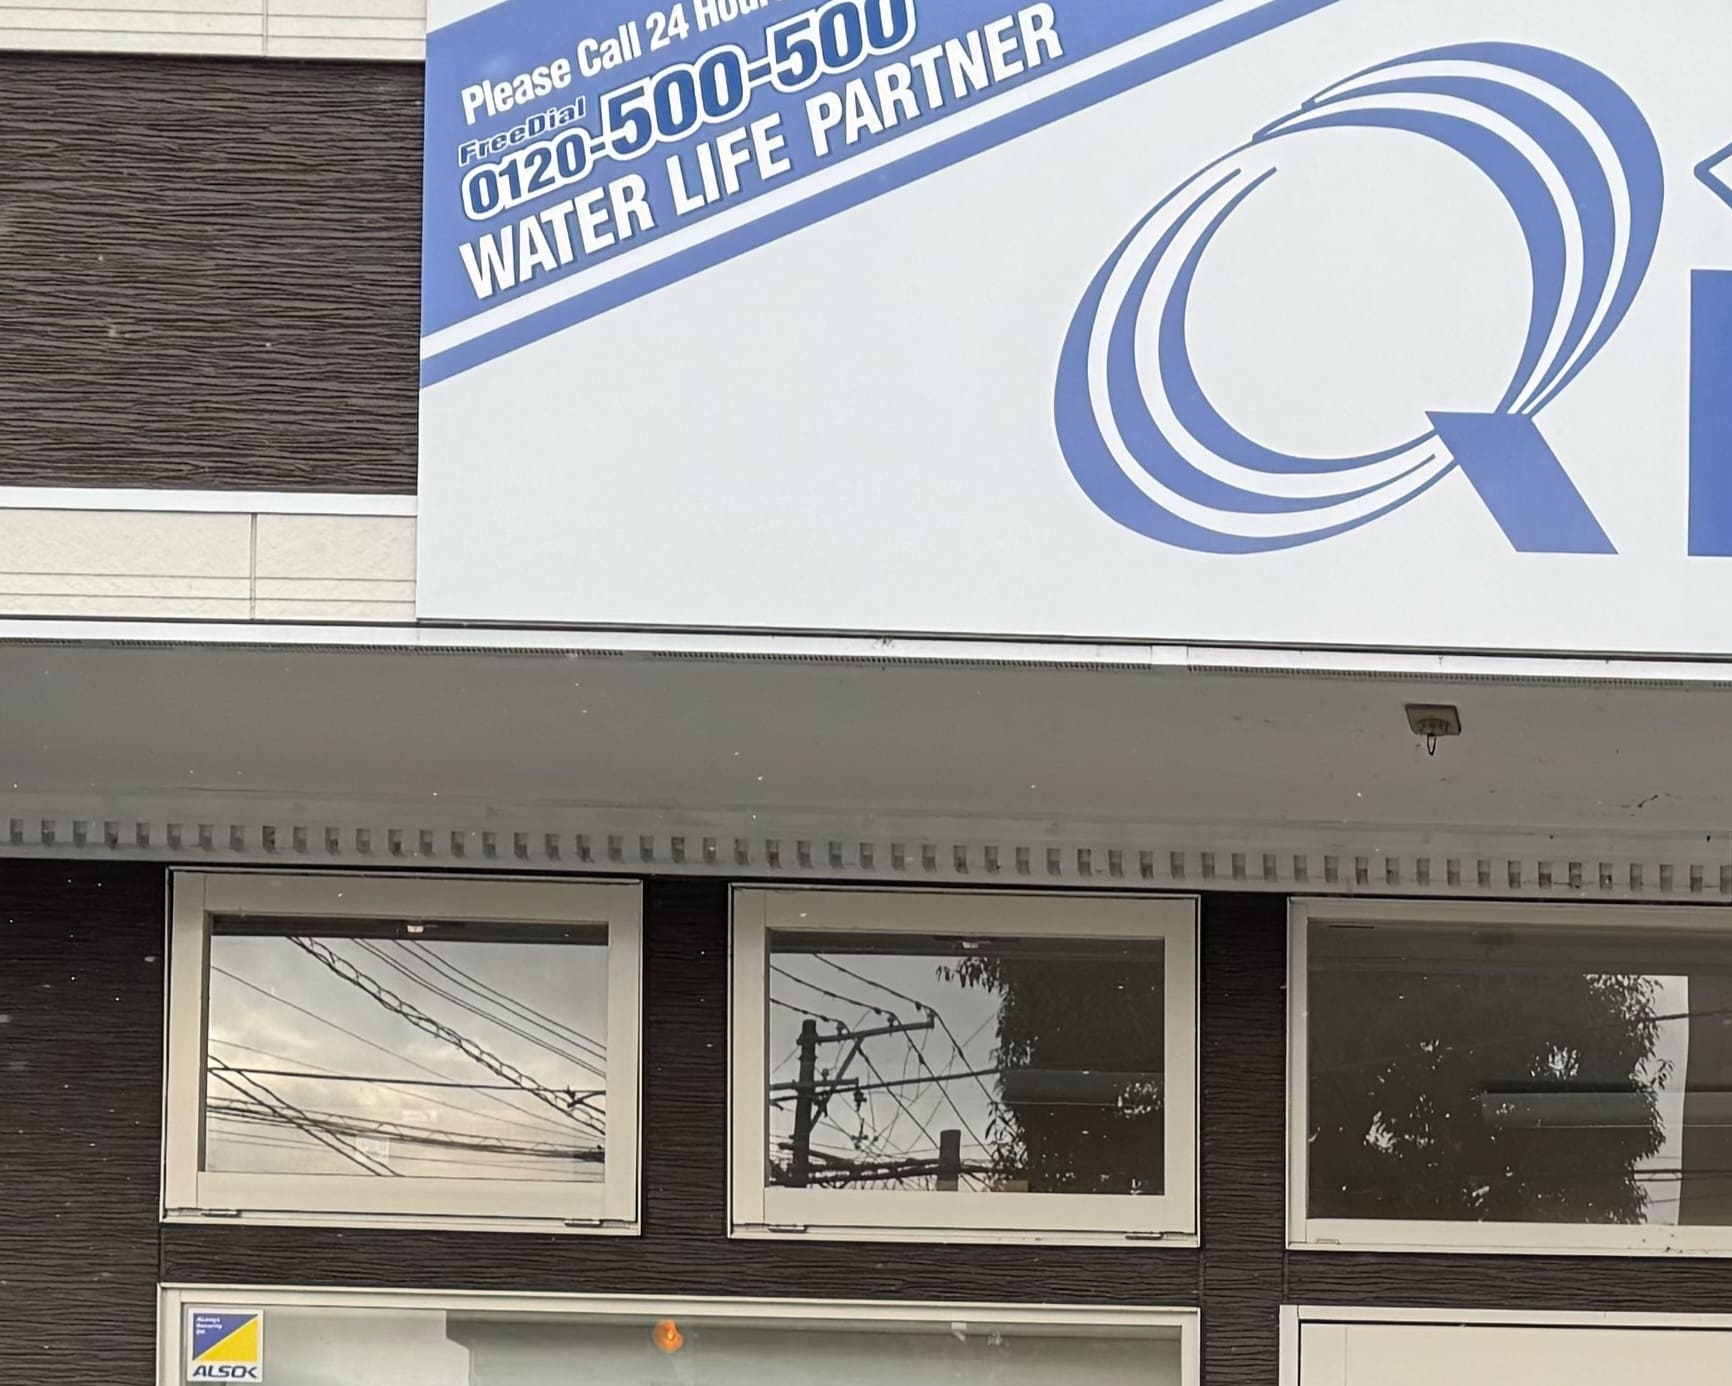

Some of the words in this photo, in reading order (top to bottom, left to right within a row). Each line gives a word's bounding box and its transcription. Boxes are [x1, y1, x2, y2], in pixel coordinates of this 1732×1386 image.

[461, 58, 572, 125] Please
[577, 20, 642, 77] Call
[645, 3, 689, 50] 24
[461, 0, 918, 221] 0120-500-500
[458, 95, 586, 167] FreeDial
[459, 173, 655, 300] WATER
[667, 113, 792, 217] LIFE
[806, 2, 1064, 157] PARTNER
[192, 1364, 257, 1378] ALSOK
